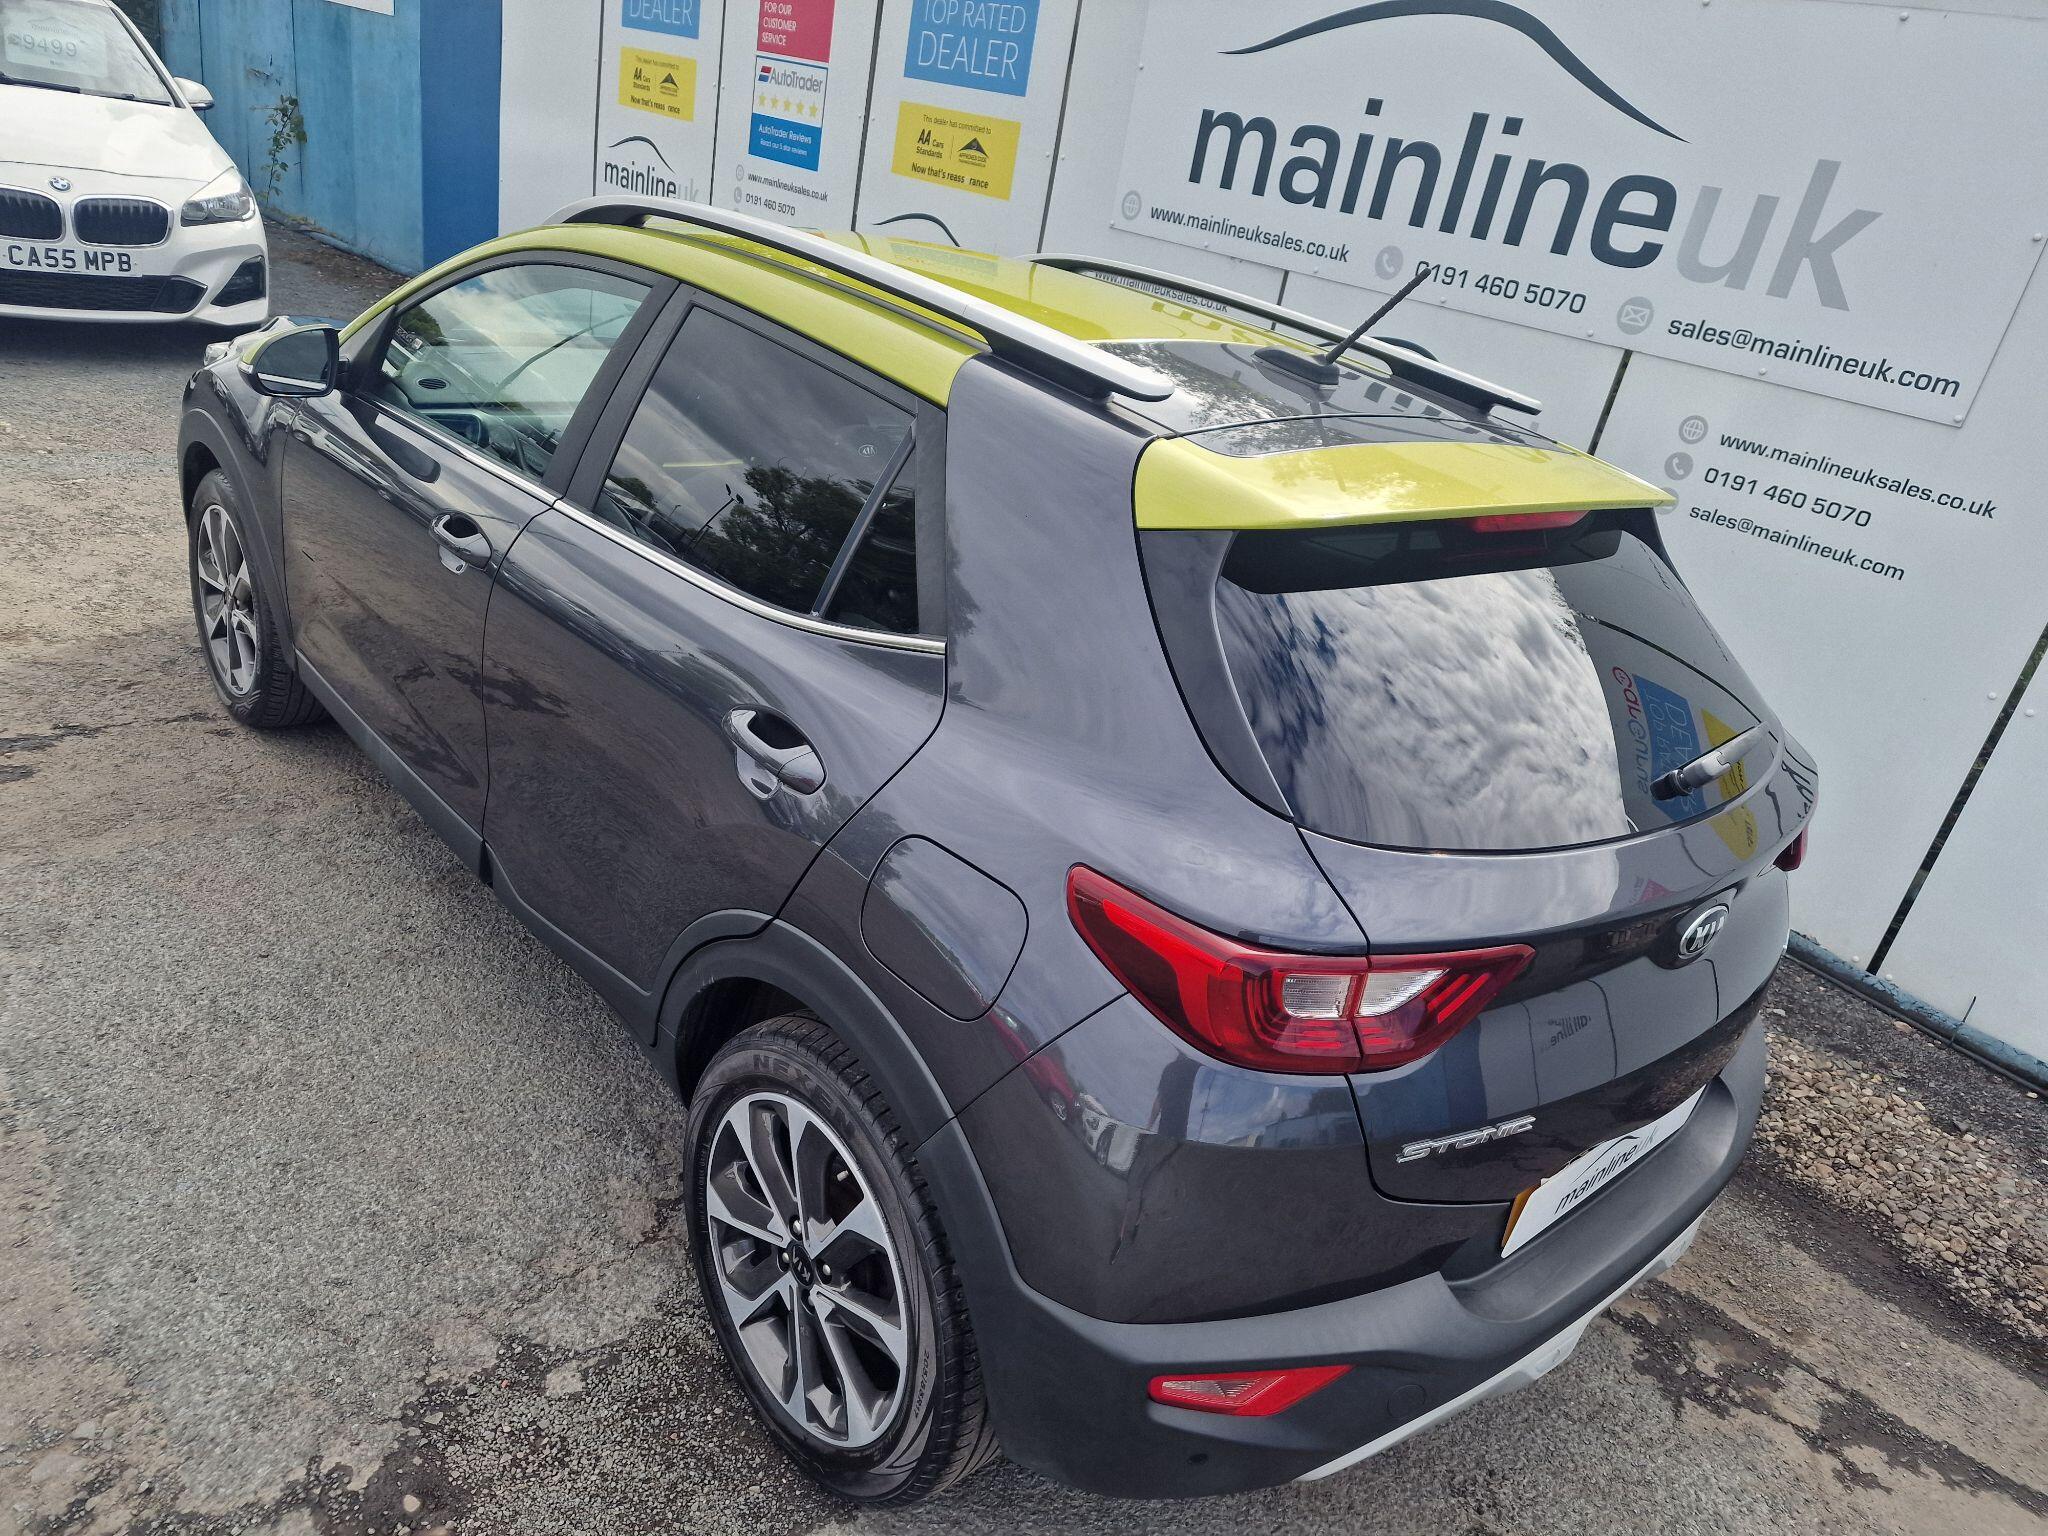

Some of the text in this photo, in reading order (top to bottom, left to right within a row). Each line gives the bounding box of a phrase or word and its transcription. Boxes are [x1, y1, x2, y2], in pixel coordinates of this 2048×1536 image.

[763, 17, 797, 32] CUSTOMER
[764, 2, 793, 15] FOR OUR
[924, 0, 1027, 34] TOP RATED
[762, 32, 787, 46] SERVICE
[918, 30, 1019, 80] DEALER
[768, 67, 823, 94] AutoTrader
[916, 146, 943, 159] Standards
[917, 128, 944, 149] AA Cars
[911, 161, 926, 175] Now
[927, 166, 946, 179] that's
[745, 193, 796, 217] 0191 460 5070
[1188, 97, 1884, 312] mainlineuk
[1150, 206, 1350, 263] www.mainlineuksales.co.uk
[7, 245, 132, 272] CA55 MPB
[1474, 274, 1519, 299] 460
[1523, 283, 1587, 314] 5070
[1667, 319, 1961, 398] sales@mainlineuk.com
[1720, 432, 1998, 519] www.mainlineuksales.co.uk
[1704, 467, 1872, 527] 0191 460 5070
[1689, 505, 1905, 581] sales@mainlineuk.com
[753, 1054, 855, 1137] NEXEN
[1396, 1114, 1537, 1164] STONIC
